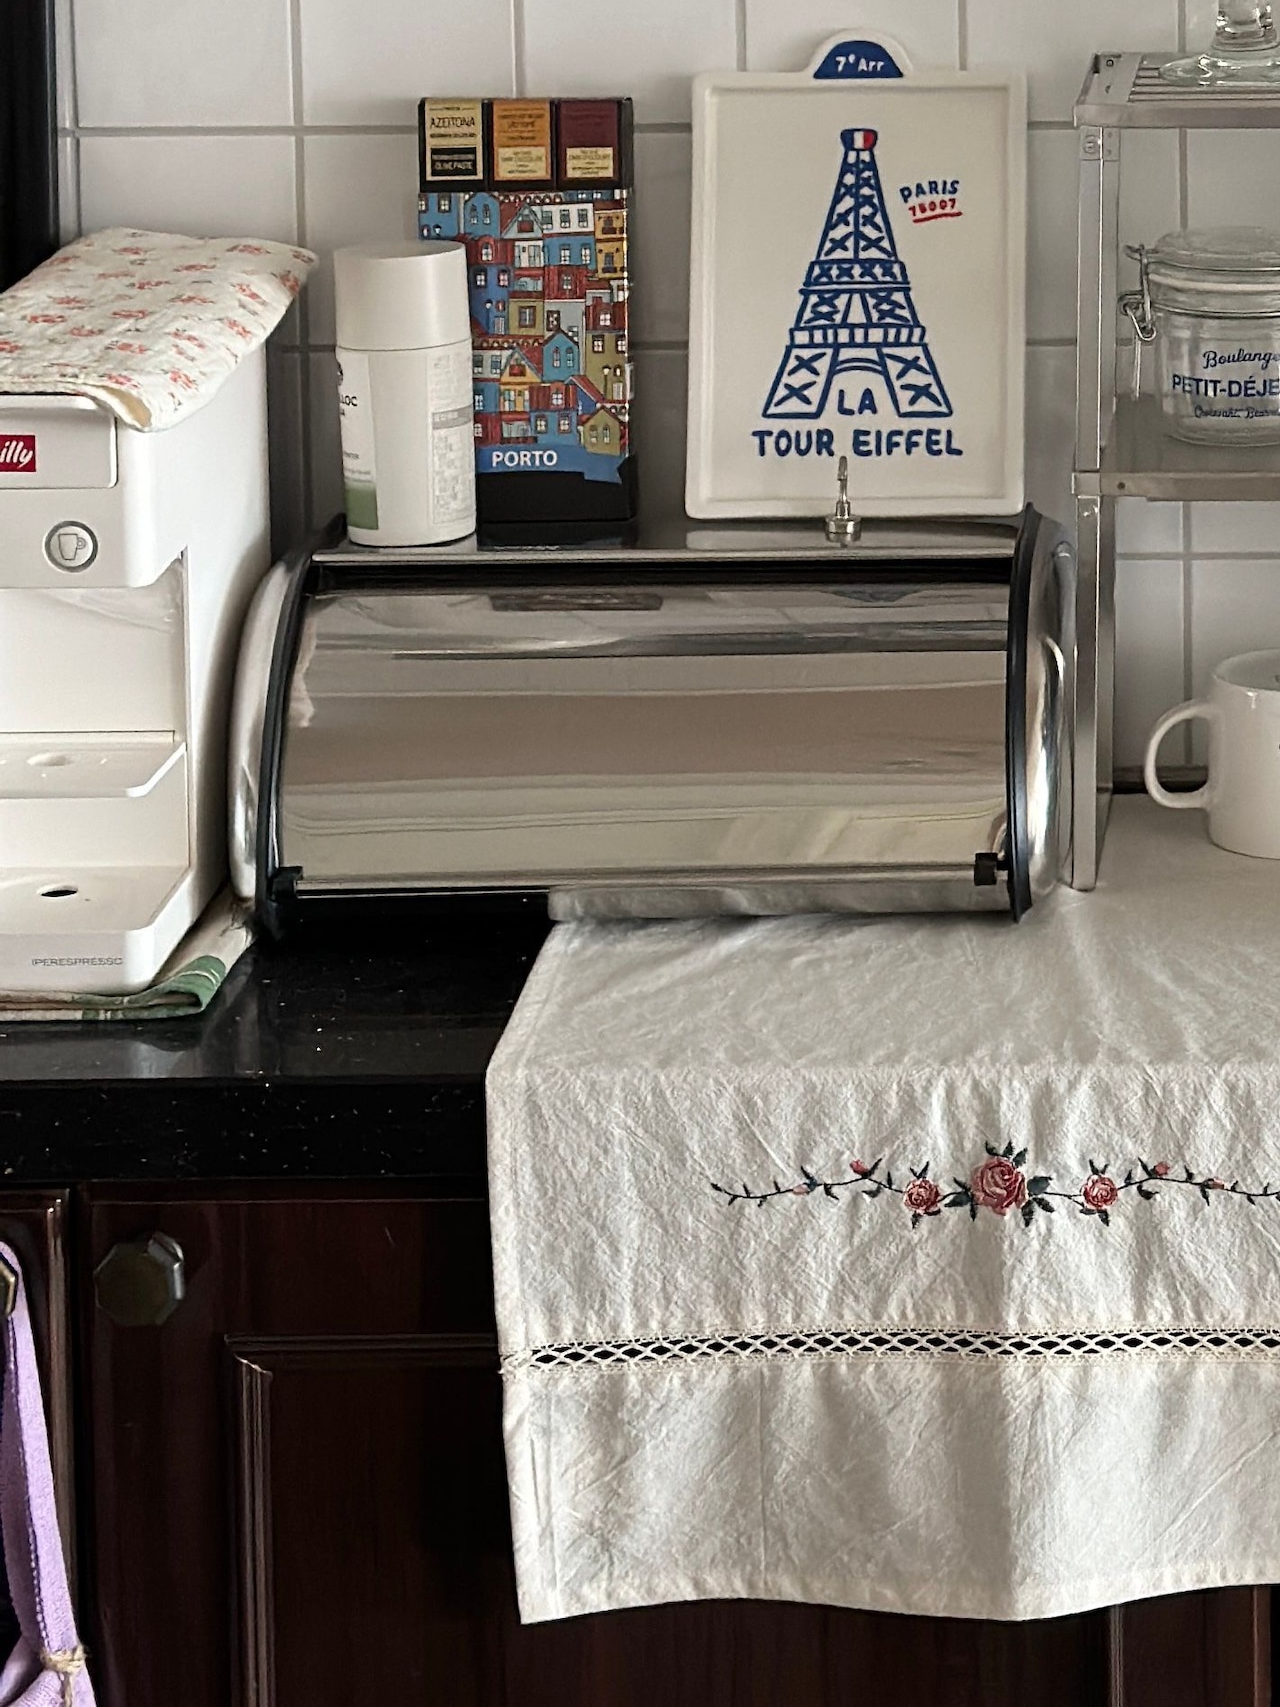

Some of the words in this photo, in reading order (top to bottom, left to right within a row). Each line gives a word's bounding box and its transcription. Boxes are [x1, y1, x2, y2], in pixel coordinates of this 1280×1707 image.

[857, 58, 885, 72] Arr
[899, 180, 960, 203] PARIS
[837, 387, 878, 415] LA
[0, 440, 33, 470] illy
[751, 428, 834, 457] TOUR
[852, 428, 963, 457] EIFFEL
[491, 450, 558, 468] PORTO
